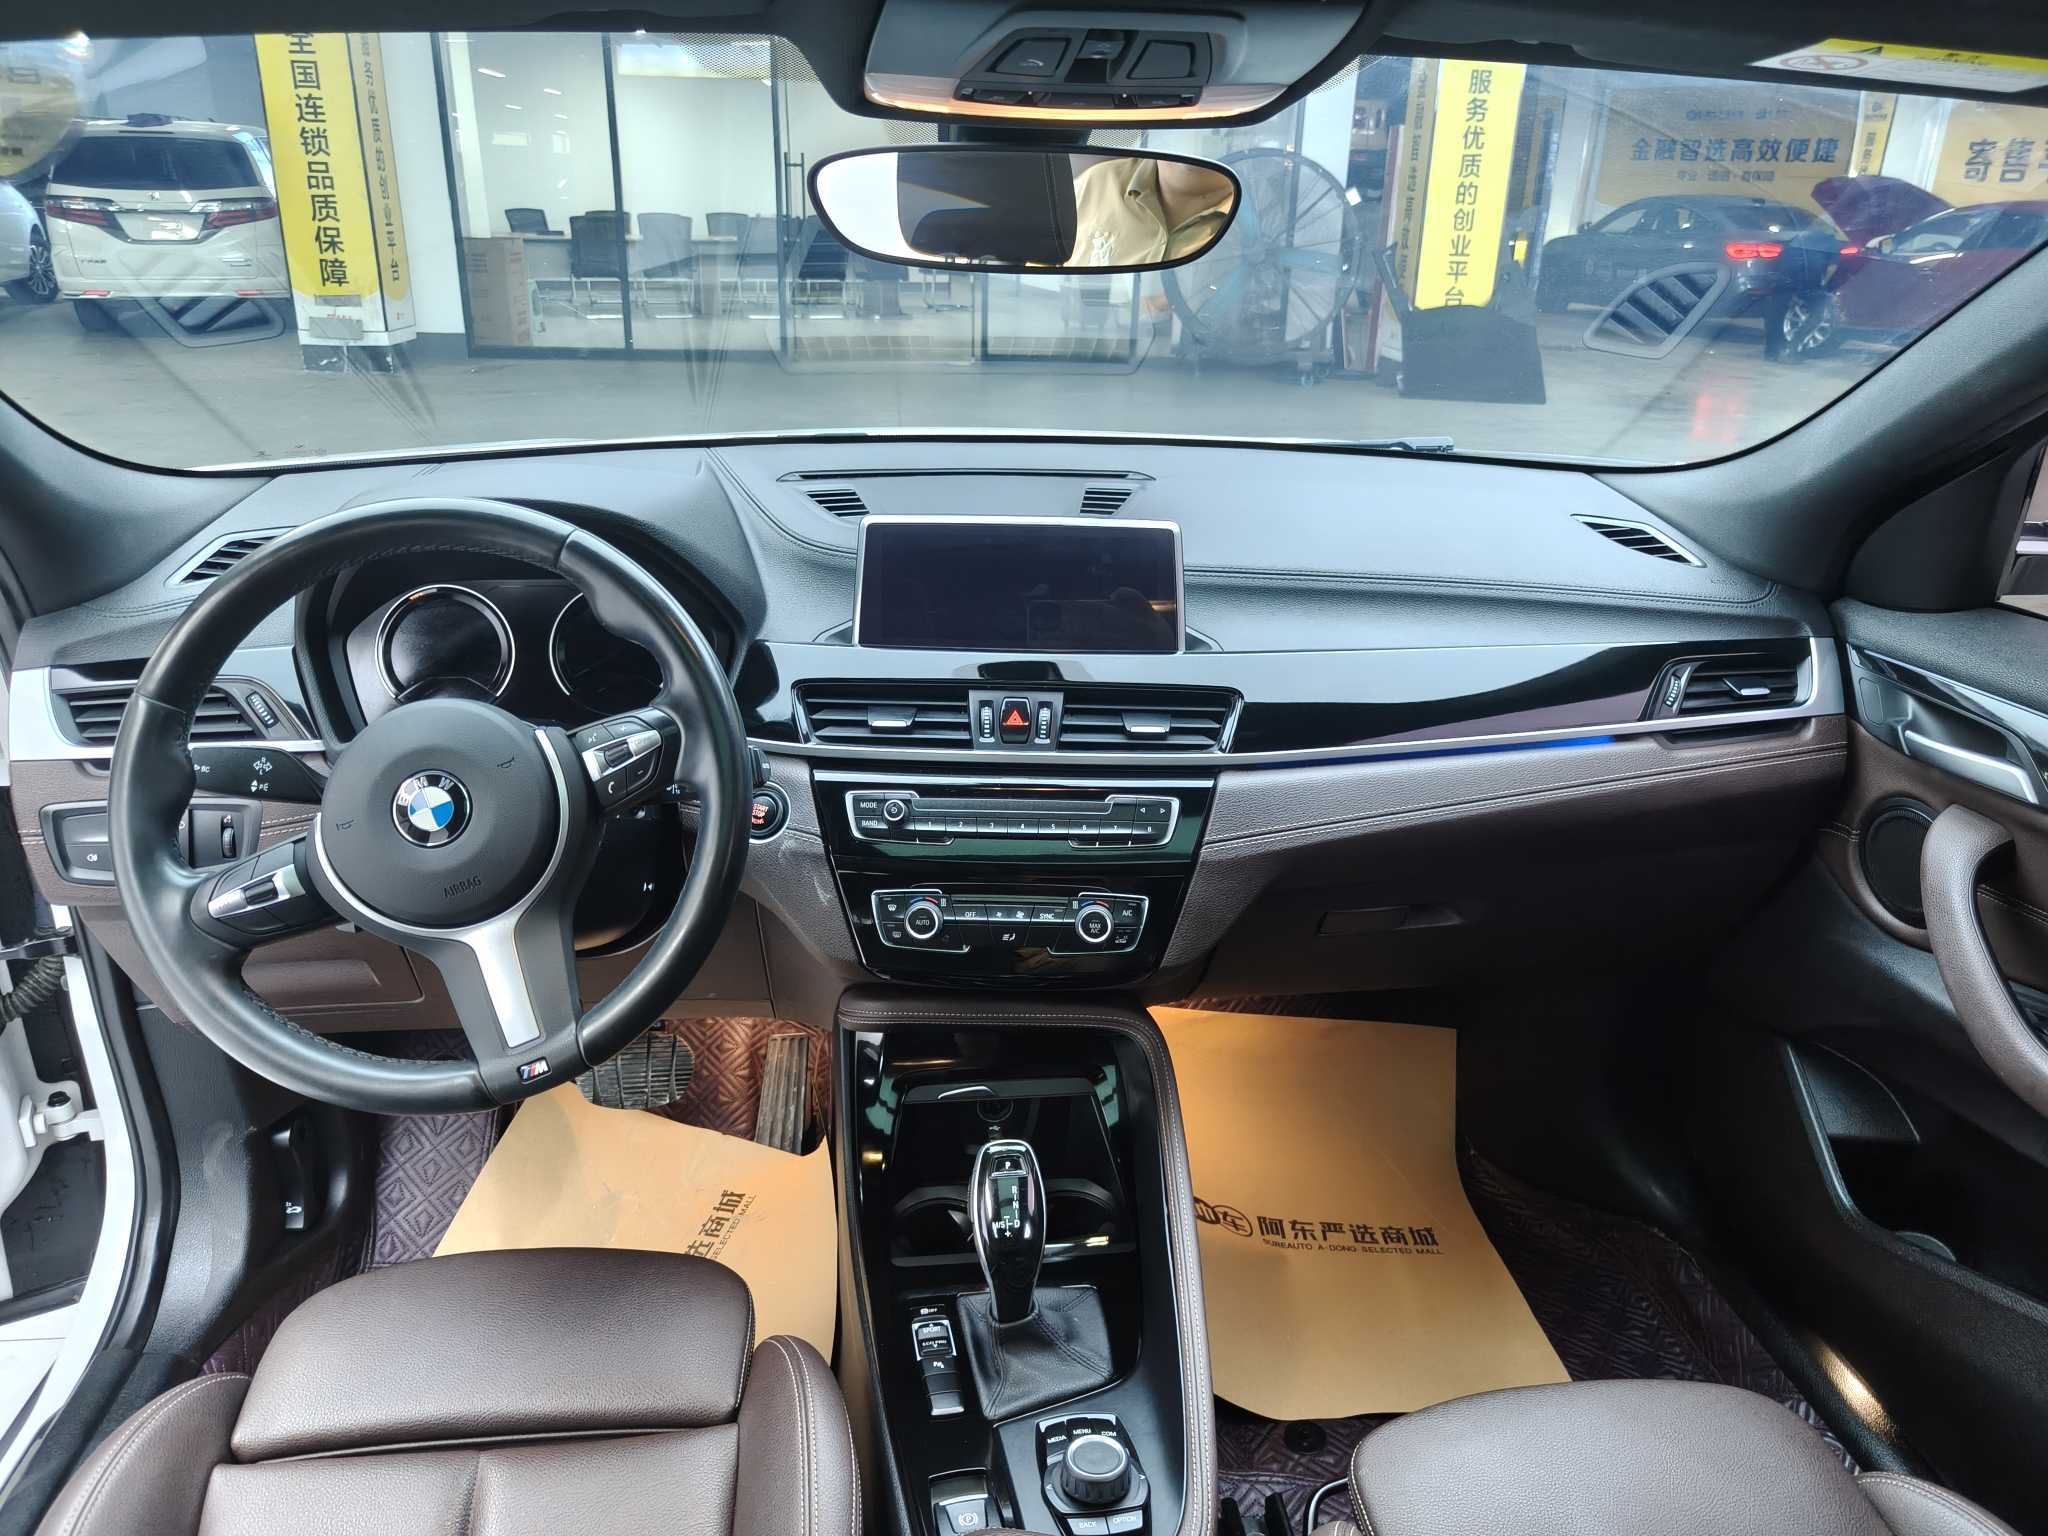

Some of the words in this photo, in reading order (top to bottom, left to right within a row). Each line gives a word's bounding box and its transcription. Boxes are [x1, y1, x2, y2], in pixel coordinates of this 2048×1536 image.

[1631, 138, 1840, 163] 金融智选高效便捷
[285, 33, 350, 287] 全国连锁品质保障
[1964, 138, 2048, 184] 寄售
[1444, 69, 1492, 306] 服务优质的创业平台
[397, 776, 454, 806] BMW
[443, 875, 481, 898] AIRBAG
[1122, 909, 1133, 917] A/C
[1005, 1161, 1011, 1170] P
[1011, 1185, 1018, 1194] R
[738, 1193, 757, 1216] MALL
[1012, 1200, 1019, 1209] N
[1014, 1220, 1020, 1228] D
[1257, 1216, 1440, 1247] 阿东严选商城
[1047, 1435, 1067, 1444] MEDIA
[1079, 1521, 1097, 1529] BACK
[1112, 1516, 1137, 1524] OPTION
